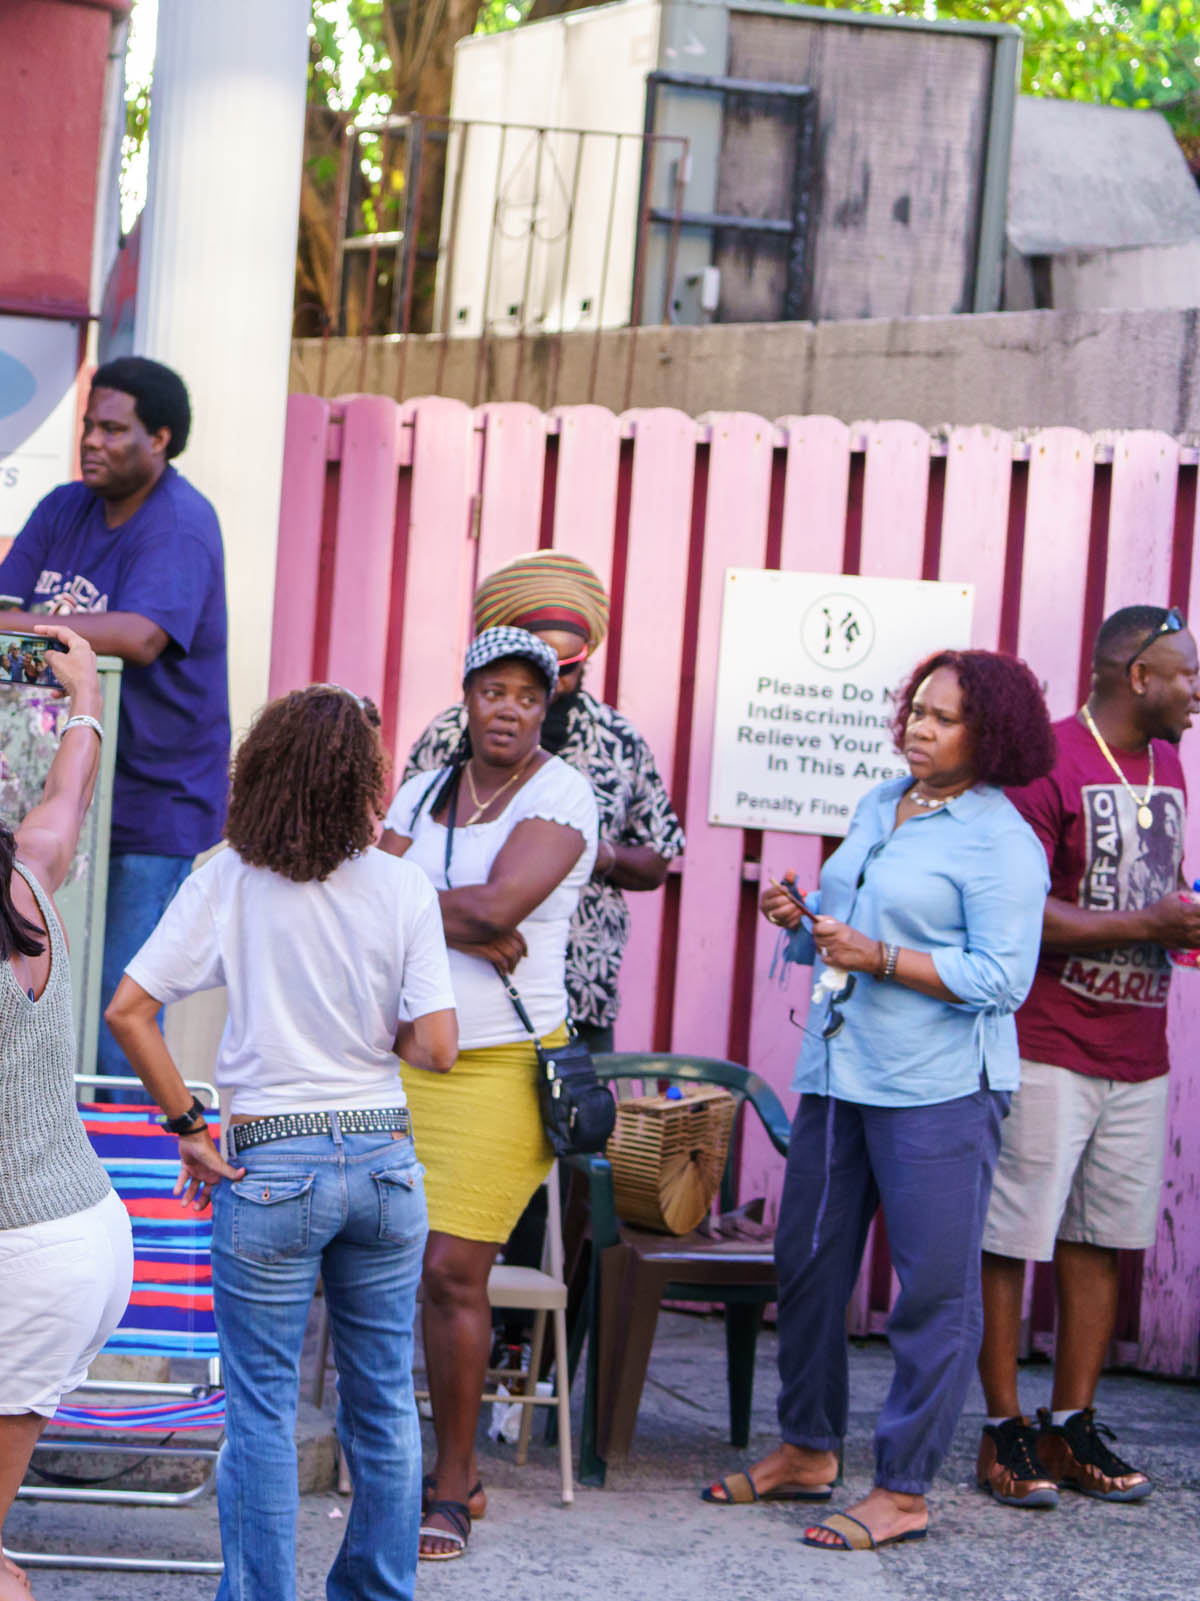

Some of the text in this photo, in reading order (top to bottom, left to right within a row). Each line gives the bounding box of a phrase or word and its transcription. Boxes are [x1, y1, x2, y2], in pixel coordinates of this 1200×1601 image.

[756, 677, 833, 698] Please
[842, 683, 874, 702] Do
[748, 702, 890, 730] Indiscrimina
[737, 726, 885, 755] Relieve Your
[768, 754, 789, 772] In
[797, 756, 846, 777] This
[736, 791, 849, 817] Penalty Fine
[1090, 791, 1118, 911] UFFALO
[1064, 961, 1169, 1003] MARLE
